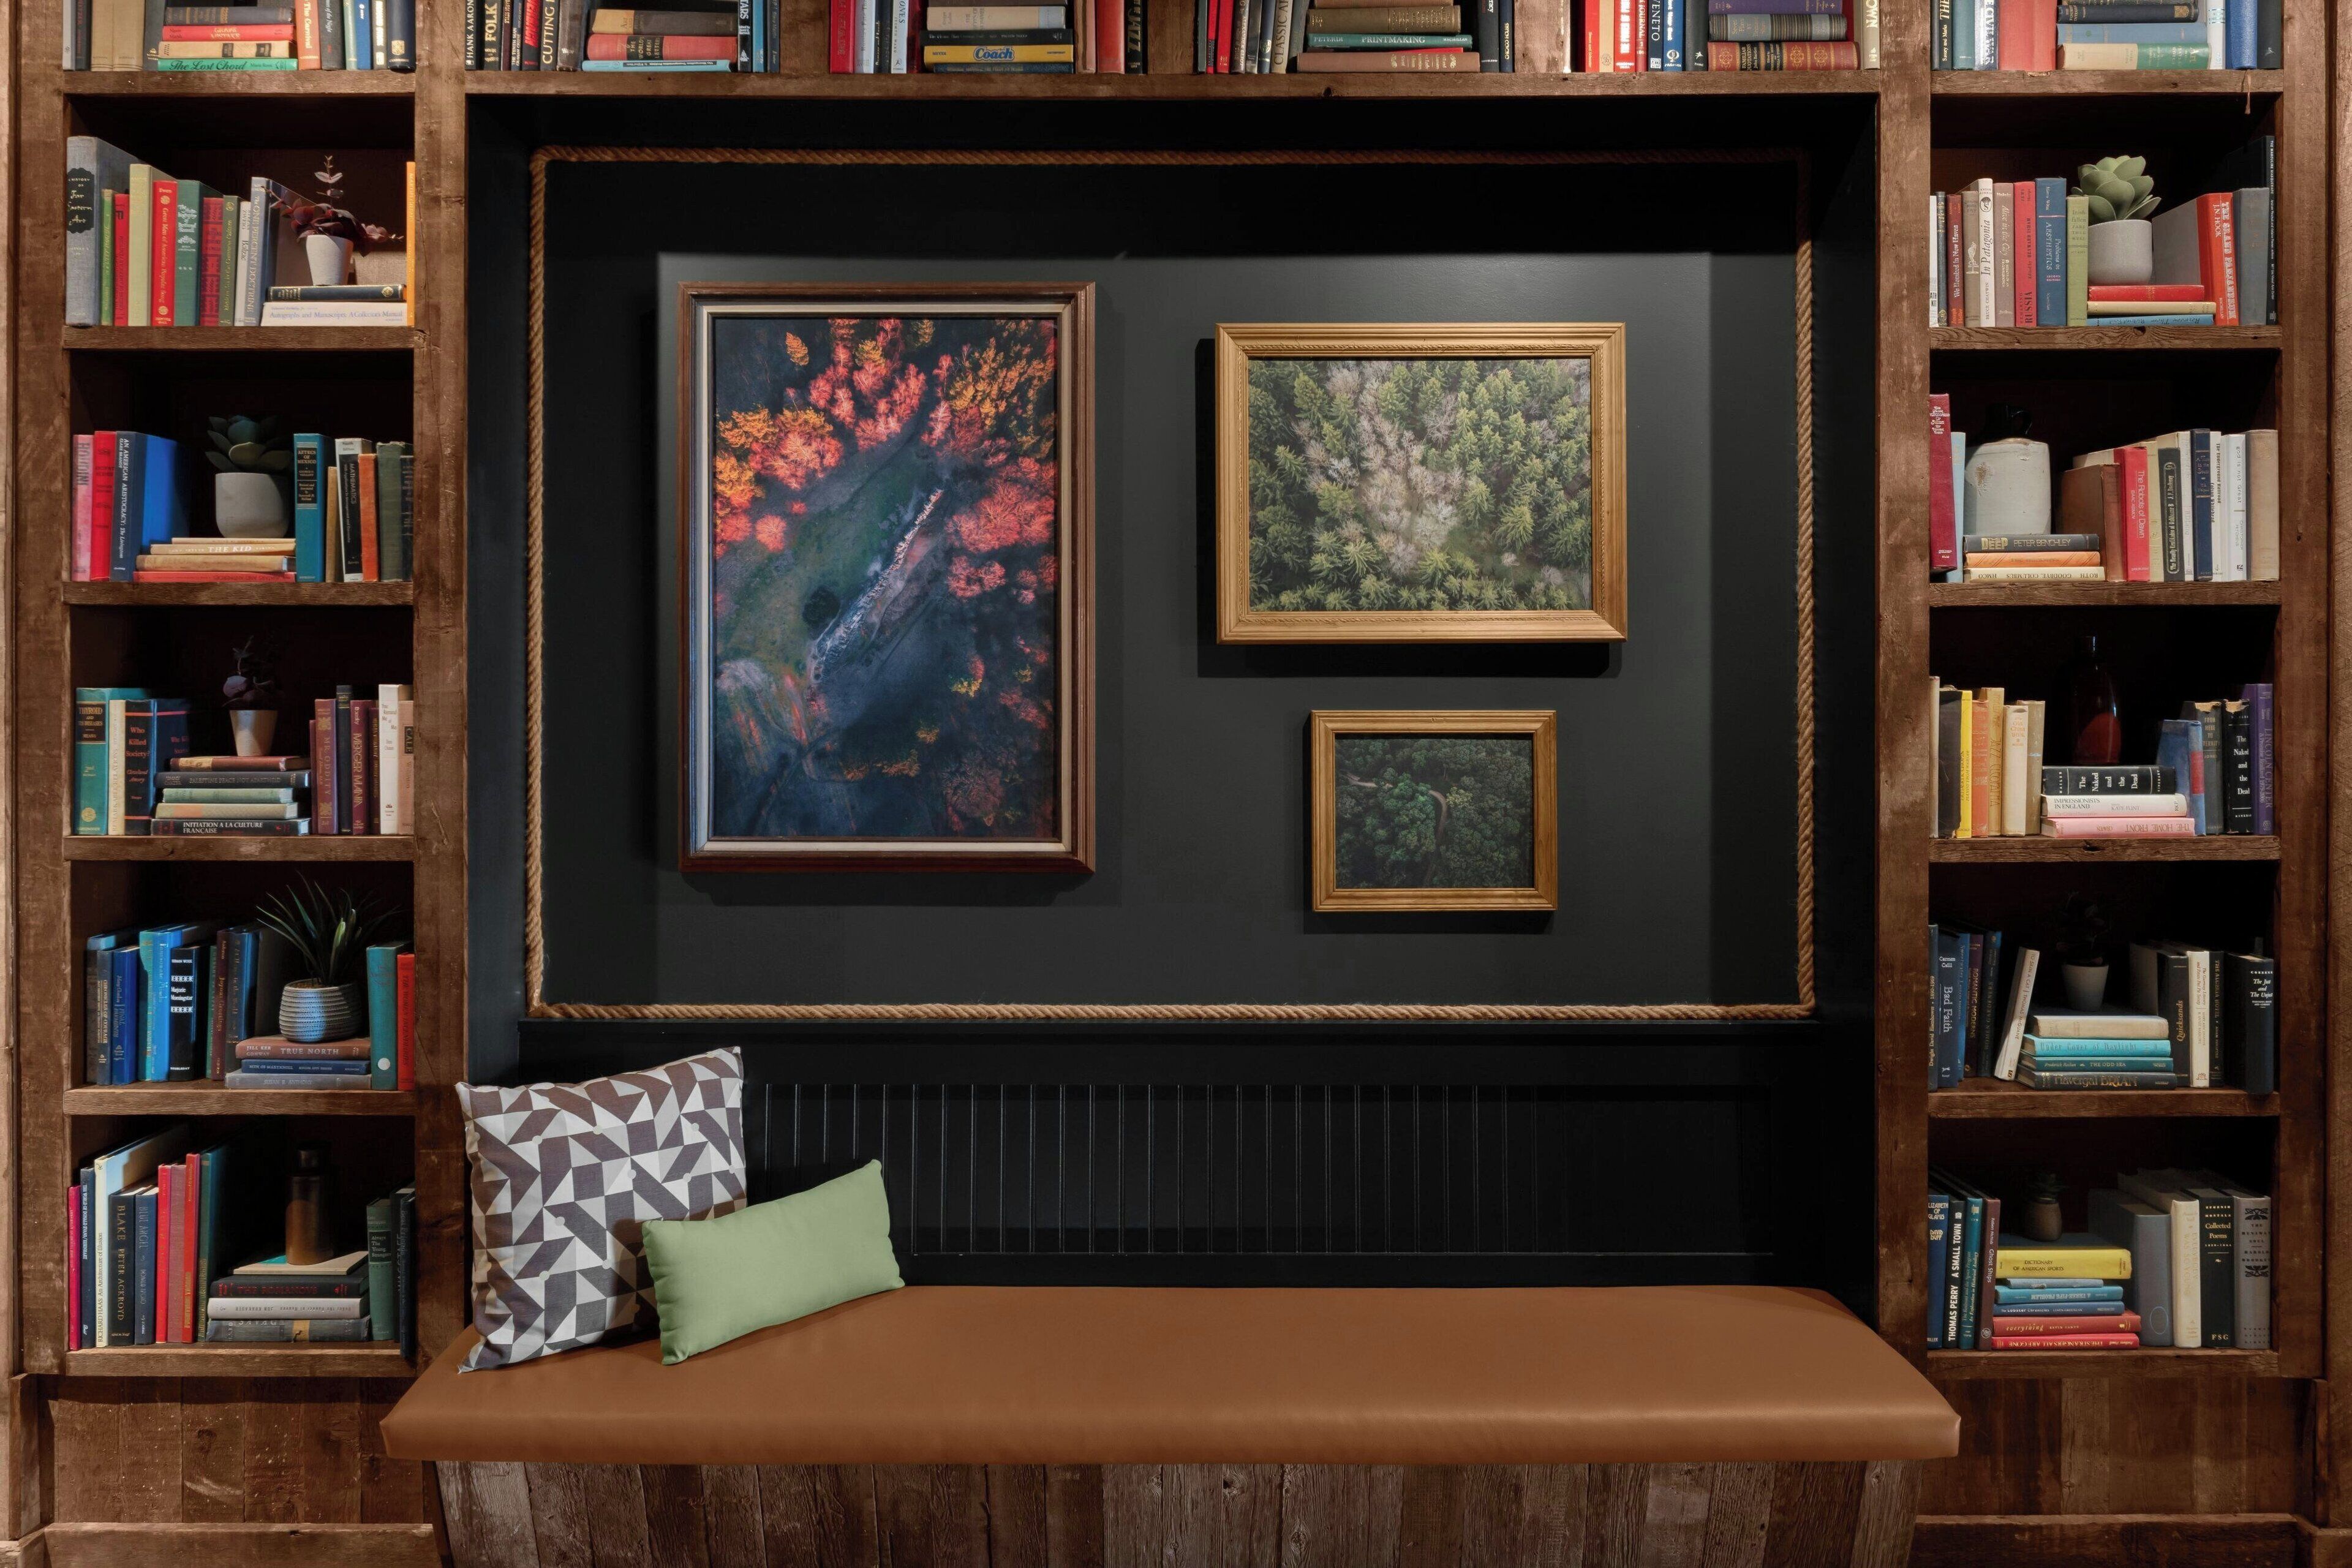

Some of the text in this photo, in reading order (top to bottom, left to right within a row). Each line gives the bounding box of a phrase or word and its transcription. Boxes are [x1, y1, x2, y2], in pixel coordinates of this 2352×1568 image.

[484, 2, 497, 41] FOLK
[542, 7, 554, 64] CUTTING
[1127, 8, 1140, 53] JAZZ
[1273, 13, 1287, 65] CLASSIC
[169, 60, 247, 70] The Lost Chord
[974, 46, 1013, 60] Coach
[2002, 205, 2010, 221] Alive
[1980, 219, 1993, 276] In Patagonia
[1999, 241, 2011, 256] City
[247, 273, 256, 311] DOCTRINE
[2024, 291, 2033, 323] RUSSIA
[76, 442, 91, 486] HOUDINI
[2013, 538, 2035, 547] PETER
[2264, 728, 2273, 769] LINCOLN
[353, 733, 363, 807] MERGER MANIA
[1989, 739, 2000, 807] JAZZ CLEOPATRA
[2125, 824, 2149, 832] FRONT
[2152, 823, 2173, 832] HOME
[1943, 986, 1953, 1033] Bad Faith
[2175, 1000, 2185, 1042] Quicksands
[116, 1205, 126, 1240] BLAKE
[138, 1205, 148, 1249] BLUE ANGEL
[1953, 1223, 1961, 1244] TOWN
[97, 1287, 104, 1296] An
[1950, 1284, 1958, 1309] PERRY
[1948, 1310, 1957, 1341] THOMAS
